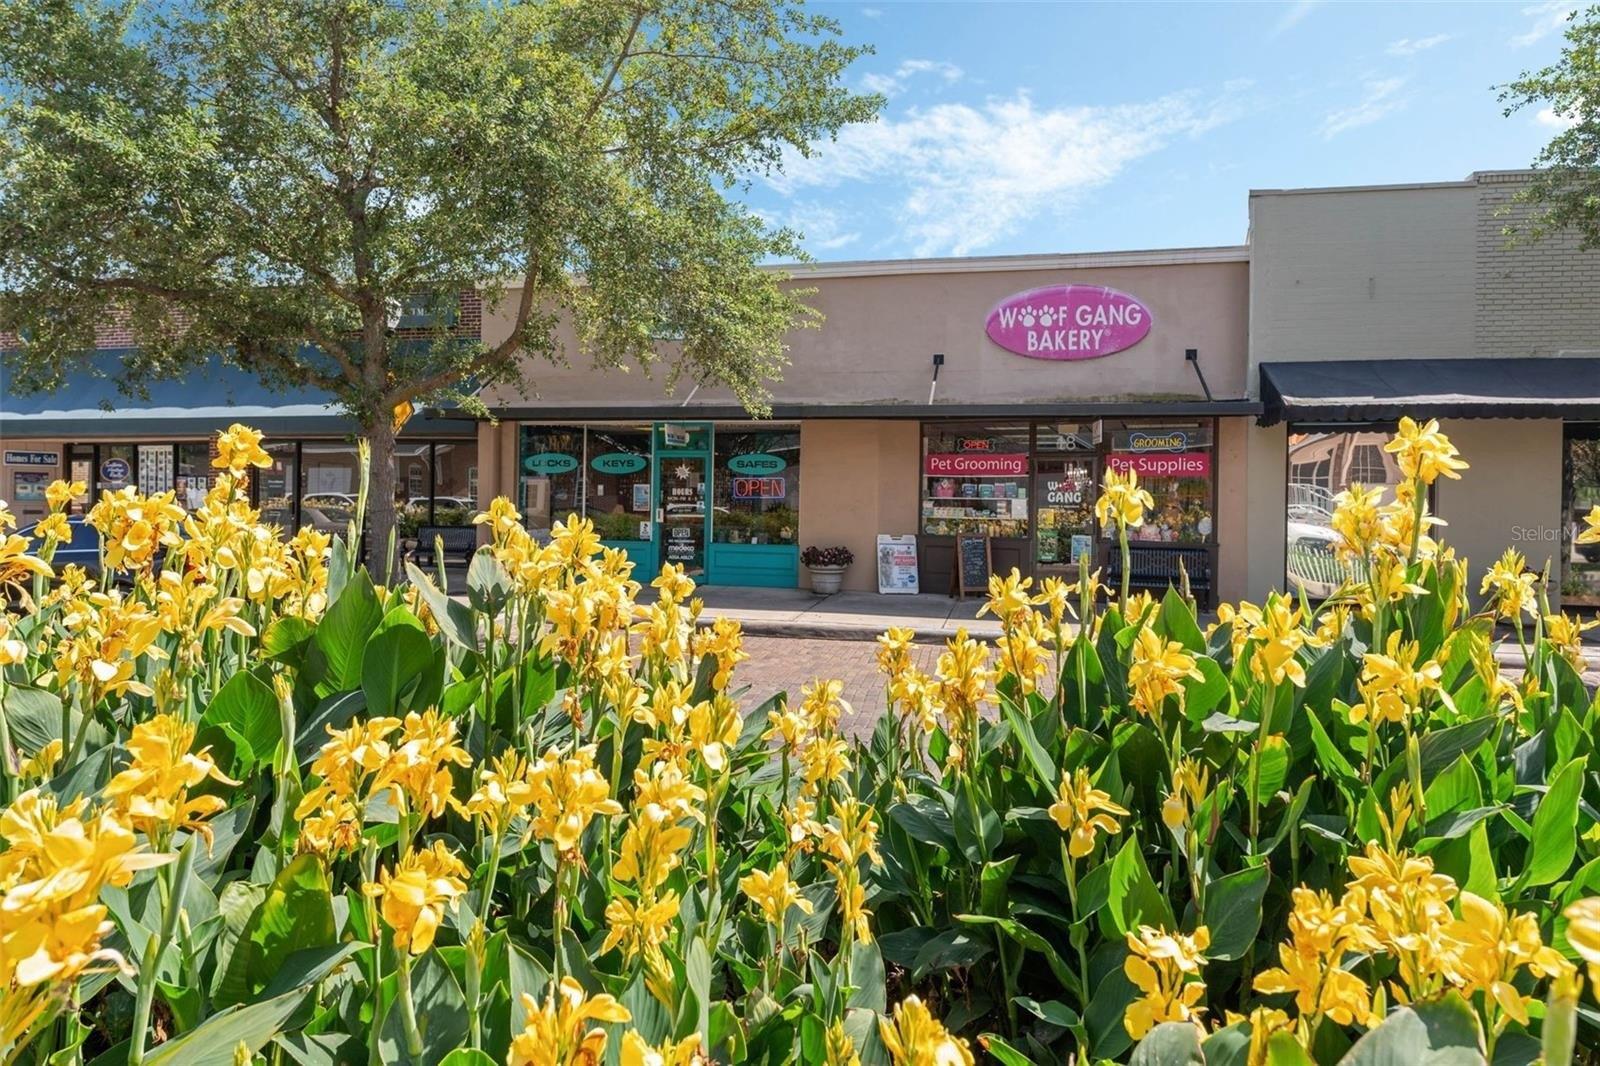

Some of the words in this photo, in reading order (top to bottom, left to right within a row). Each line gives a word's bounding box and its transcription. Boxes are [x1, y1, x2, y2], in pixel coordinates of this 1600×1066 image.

[1075, 304, 1142, 326] GANG
[1027, 329, 1103, 352] BAKERY
[963, 440, 989, 449] OPEN
[1133, 438, 1183, 448] GROOMING
[6, 453, 28, 463] Homes
[30, 454, 41, 463] For
[43, 454, 57, 464] Sale
[603, 459, 635, 467] KEYS
[736, 460, 778, 468] SAFES
[931, 458, 951, 470] Pet
[954, 457, 1022, 473] Grooming
[1111, 458, 1134, 472] Pet
[1138, 457, 1204, 474] Supplies
[735, 479, 783, 496] OPEN
[1047, 491, 1082, 503] GANG
